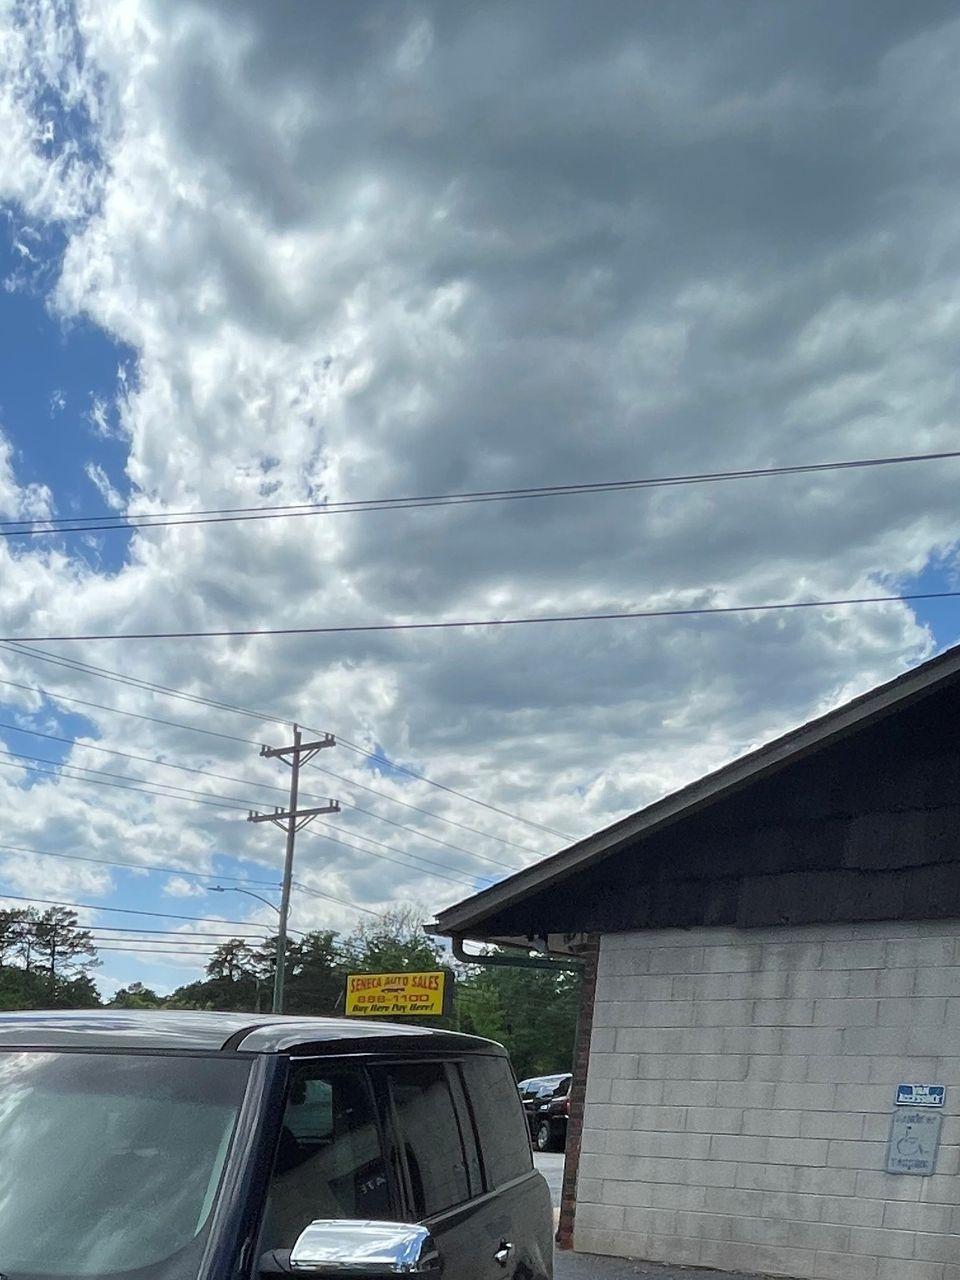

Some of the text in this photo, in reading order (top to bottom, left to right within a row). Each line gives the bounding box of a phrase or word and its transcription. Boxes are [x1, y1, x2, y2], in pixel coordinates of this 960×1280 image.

[351, 976, 439, 993] SENECA AUTO SALES
[352, 1003, 434, 1013] Buy Here Pay Here!
